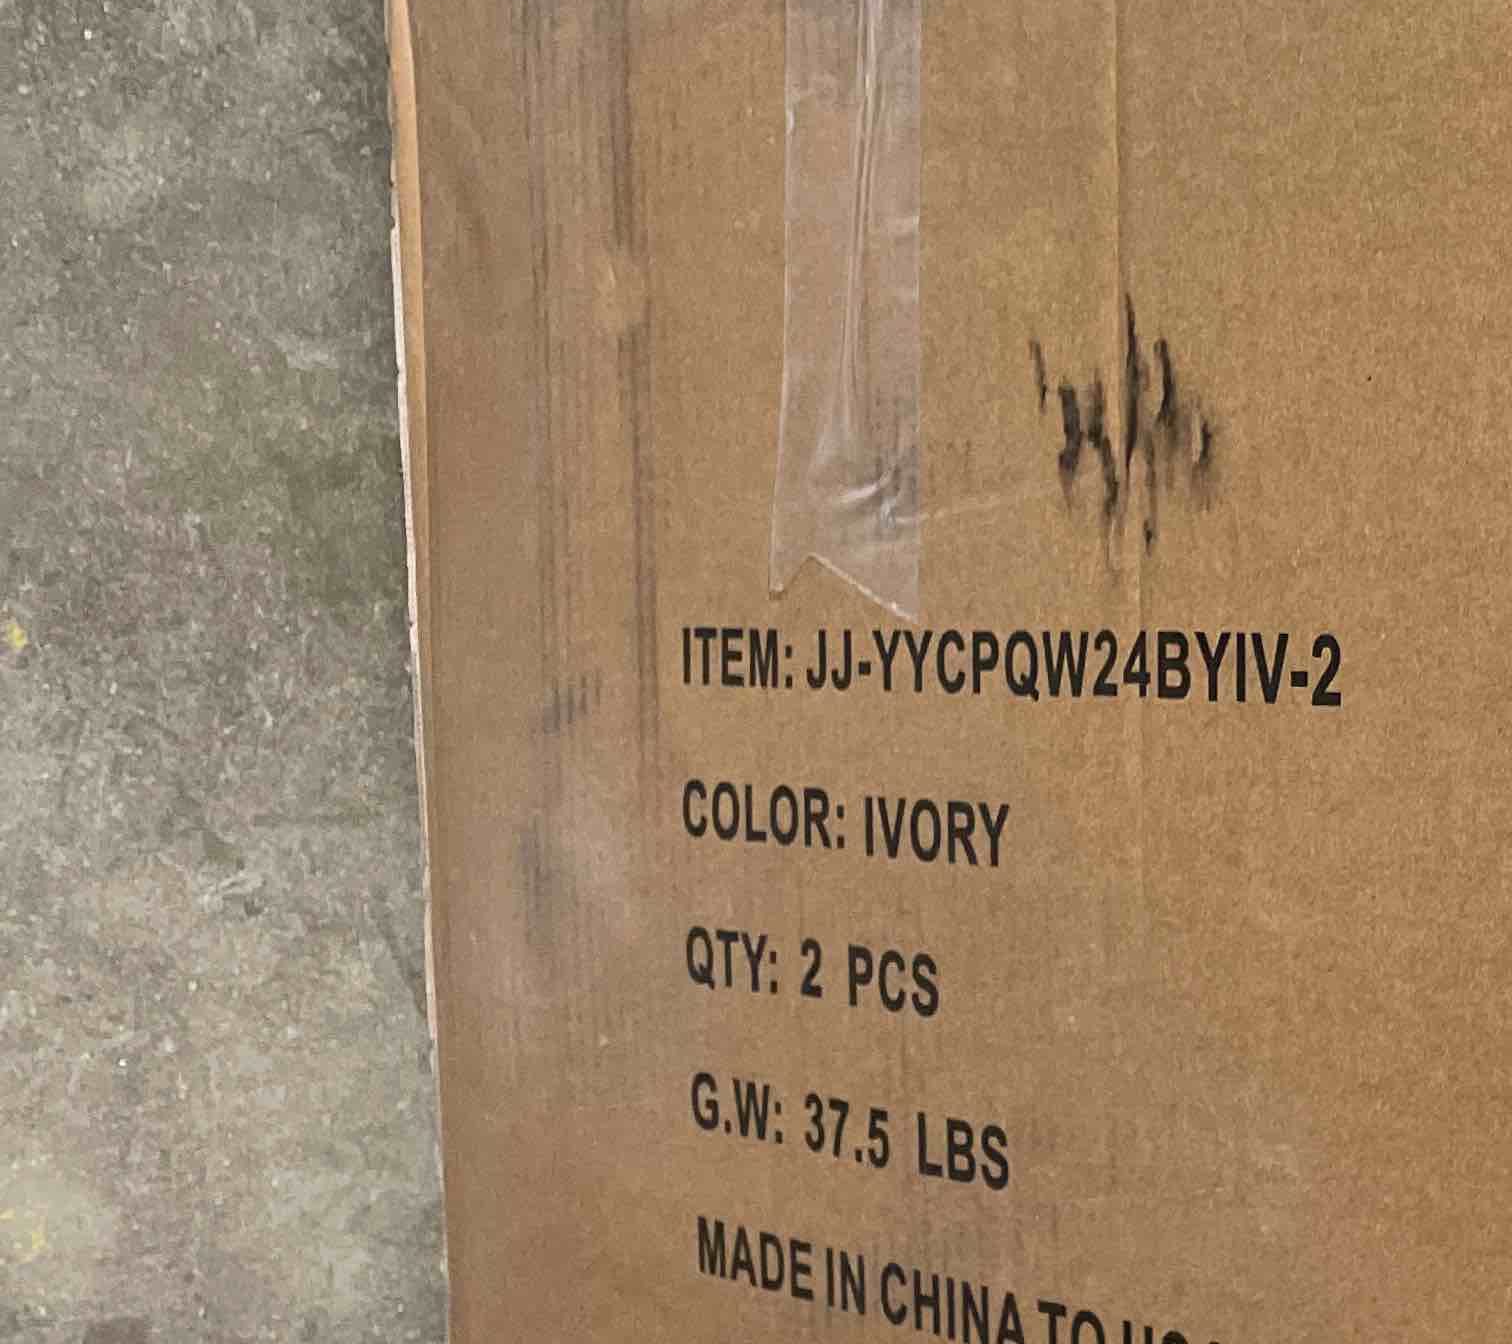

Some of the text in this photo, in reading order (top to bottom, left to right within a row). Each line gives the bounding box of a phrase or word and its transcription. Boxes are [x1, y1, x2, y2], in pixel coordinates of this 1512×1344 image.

[682, 626, 1343, 708] ITEM: JJ-YYCPQW24BYIV-2
[682, 778, 1011, 869] COLOR: IVORY
[685, 924, 940, 1018] QTY: 2 PCS
[690, 1070, 1010, 1192] G.W: 37.5 LBS
[696, 1214, 816, 1303] MADE
[824, 1246, 868, 1317] IN
